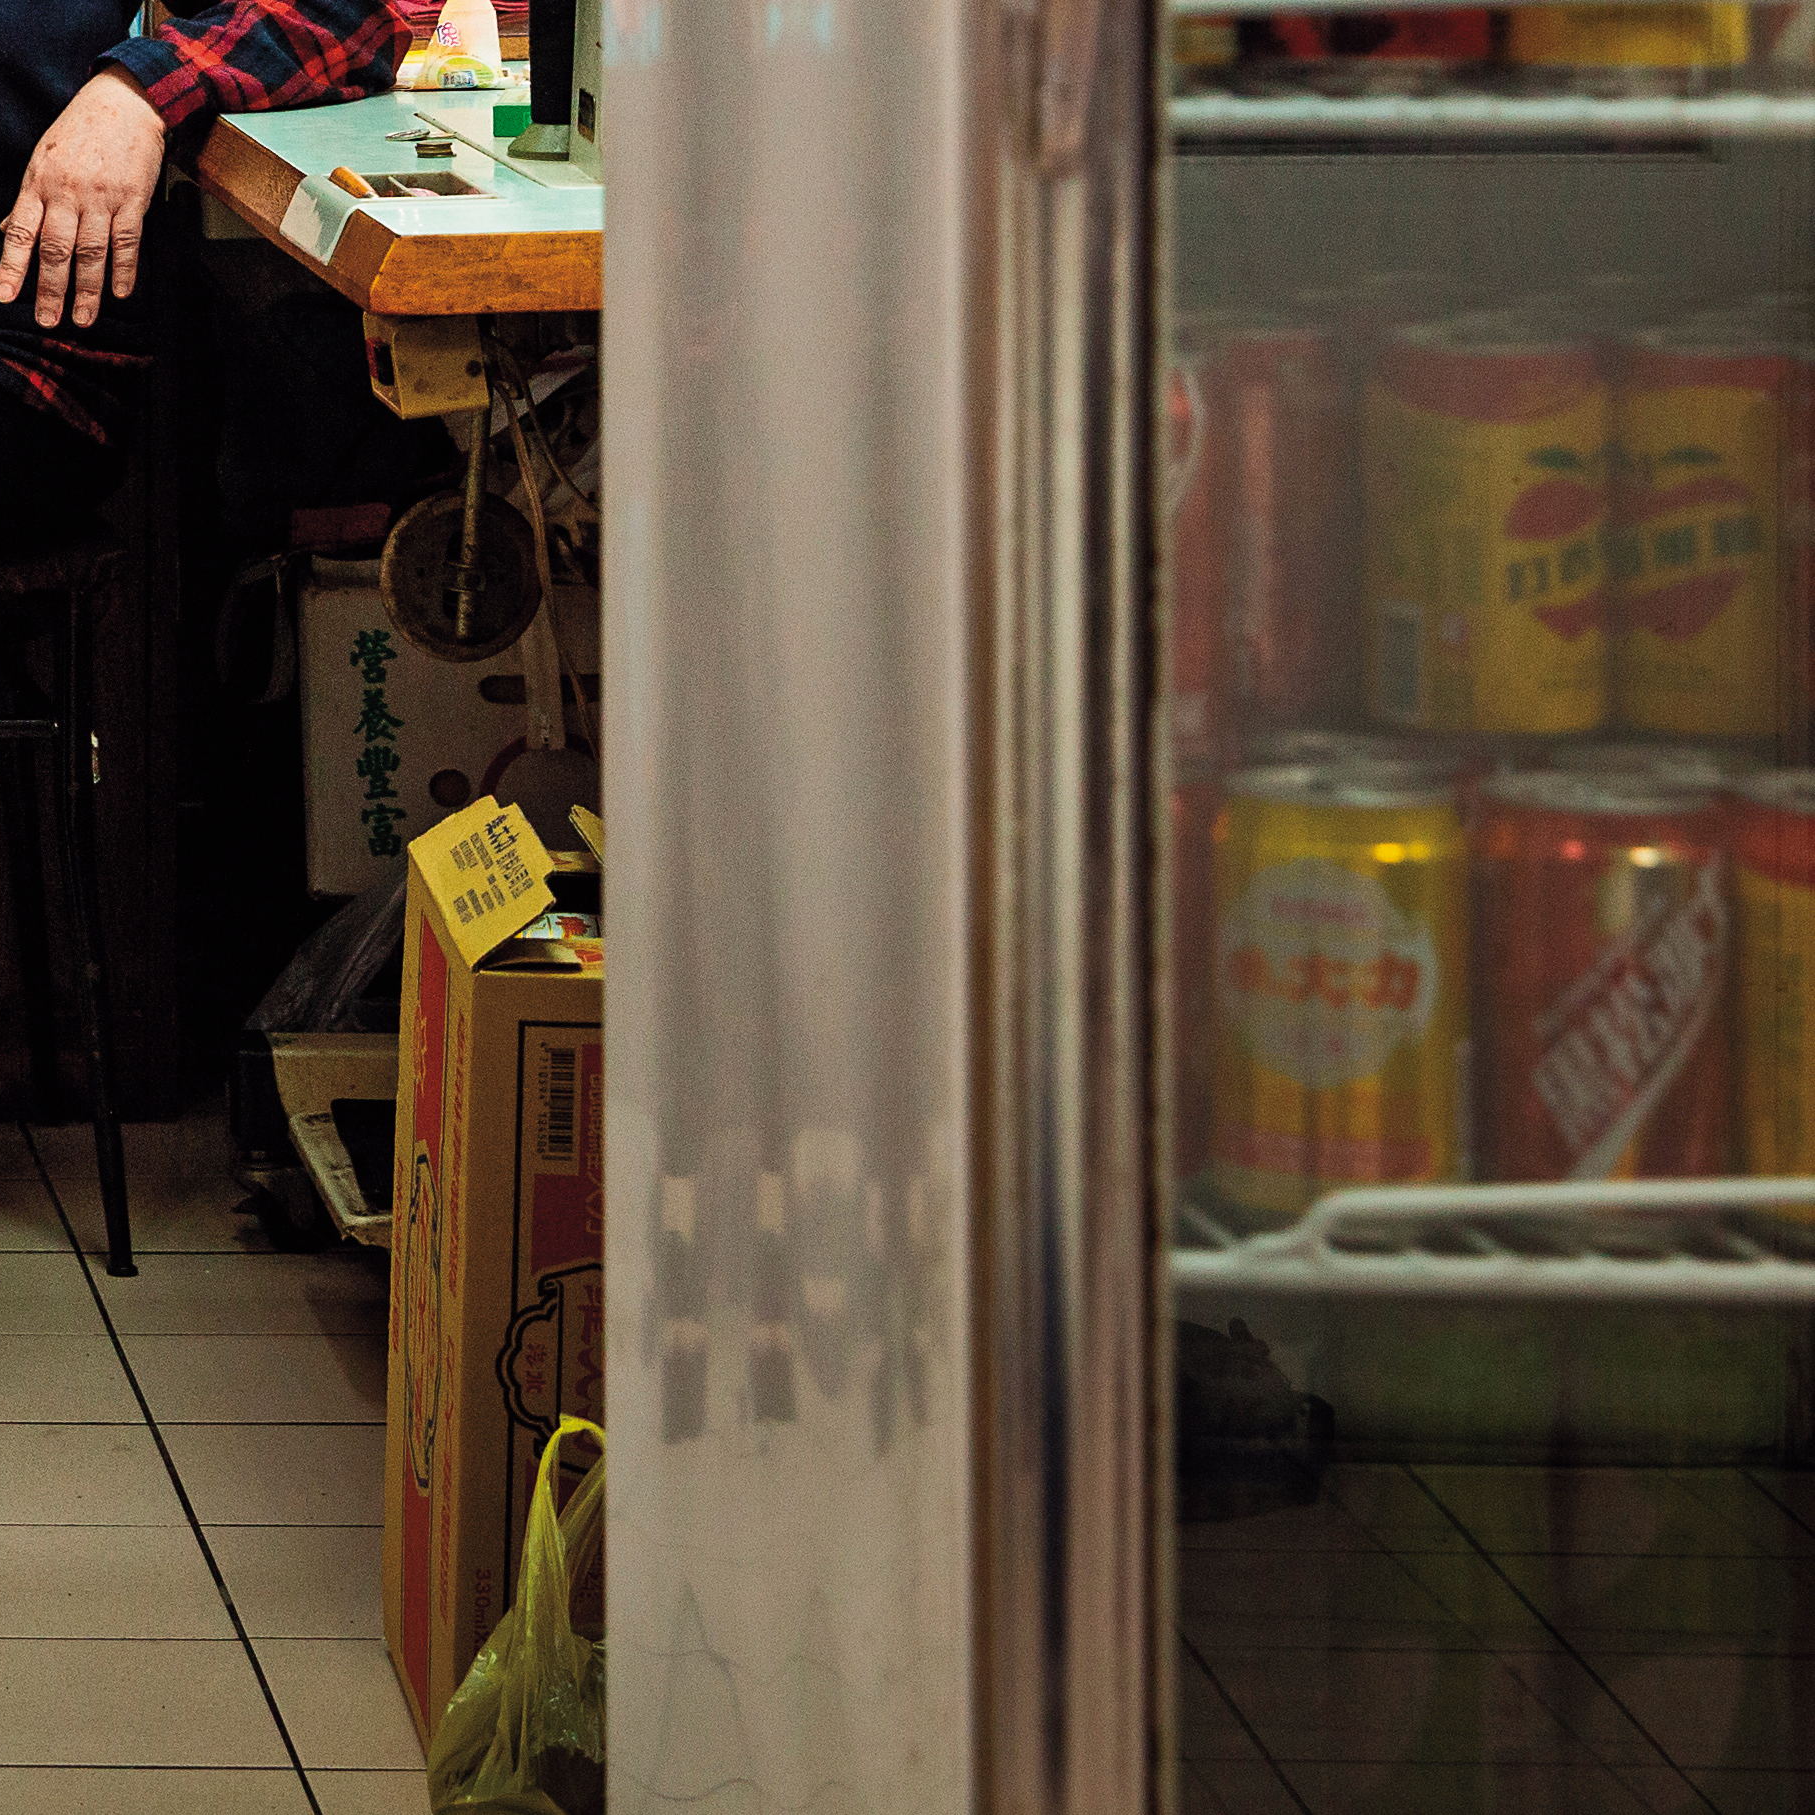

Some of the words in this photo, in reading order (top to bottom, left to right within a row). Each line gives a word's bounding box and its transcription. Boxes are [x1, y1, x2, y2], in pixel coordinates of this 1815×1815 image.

[350, 630, 407, 858] 營養豐富
[473, 1568, 491, 1658] 330mlX
